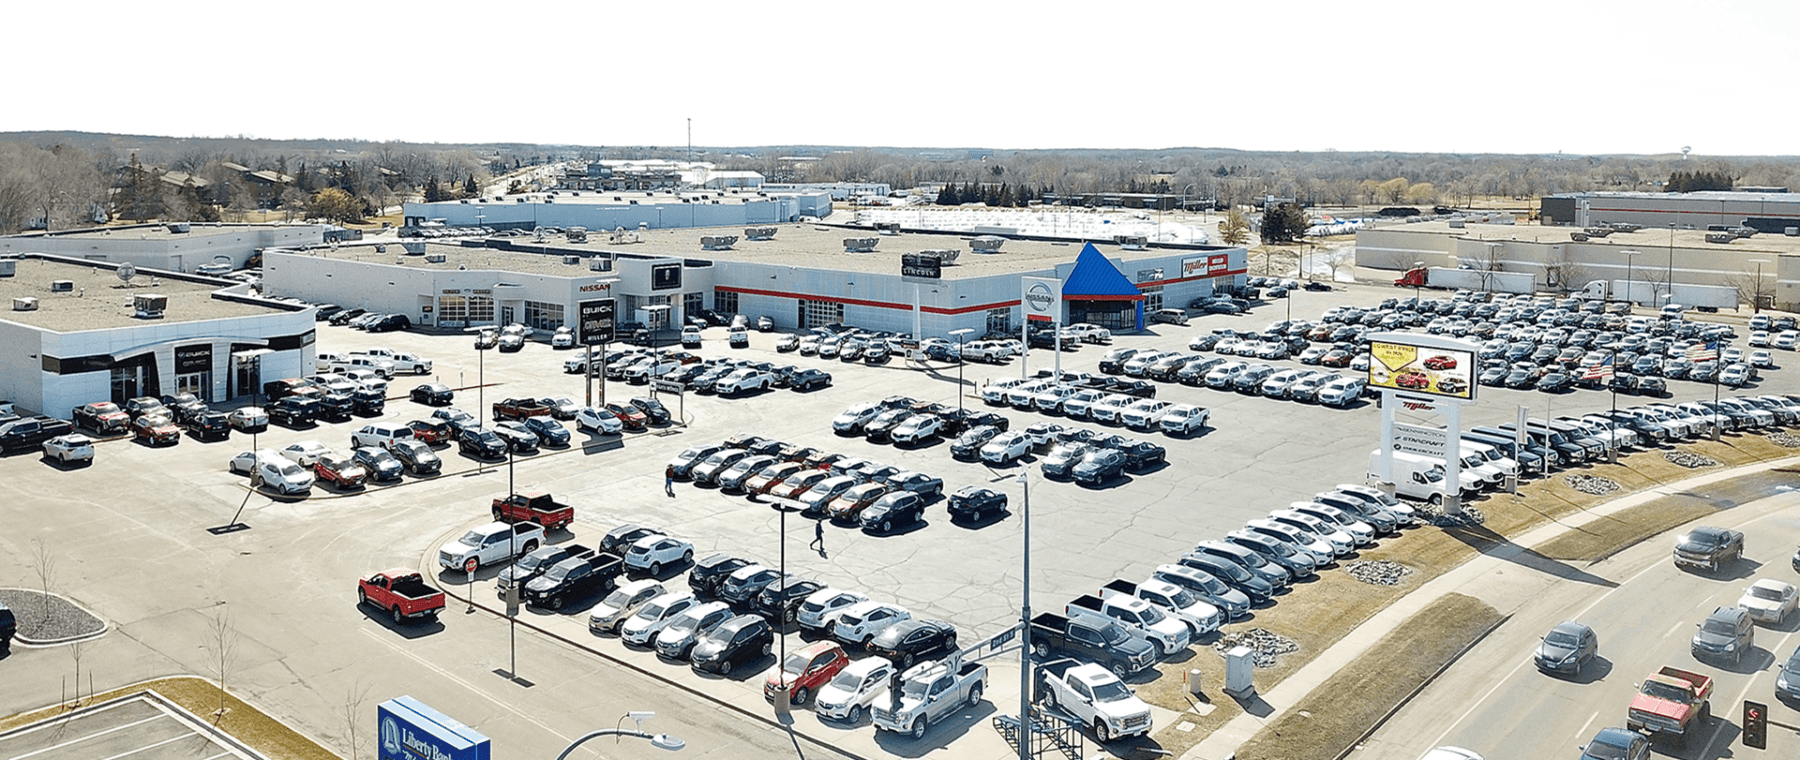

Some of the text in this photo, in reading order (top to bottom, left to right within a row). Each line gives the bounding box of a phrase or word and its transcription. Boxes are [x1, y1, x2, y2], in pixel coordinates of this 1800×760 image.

[903, 268, 936, 277] LINCOLN
[1184, 260, 1207, 274] Miller
[579, 284, 611, 292] NISSAN
[582, 305, 612, 315] BUICK
[1402, 436, 1445, 447] STARCRAFT
[992, 636, 1003, 648] 2nd
[402, 727, 432, 760] Liberty
